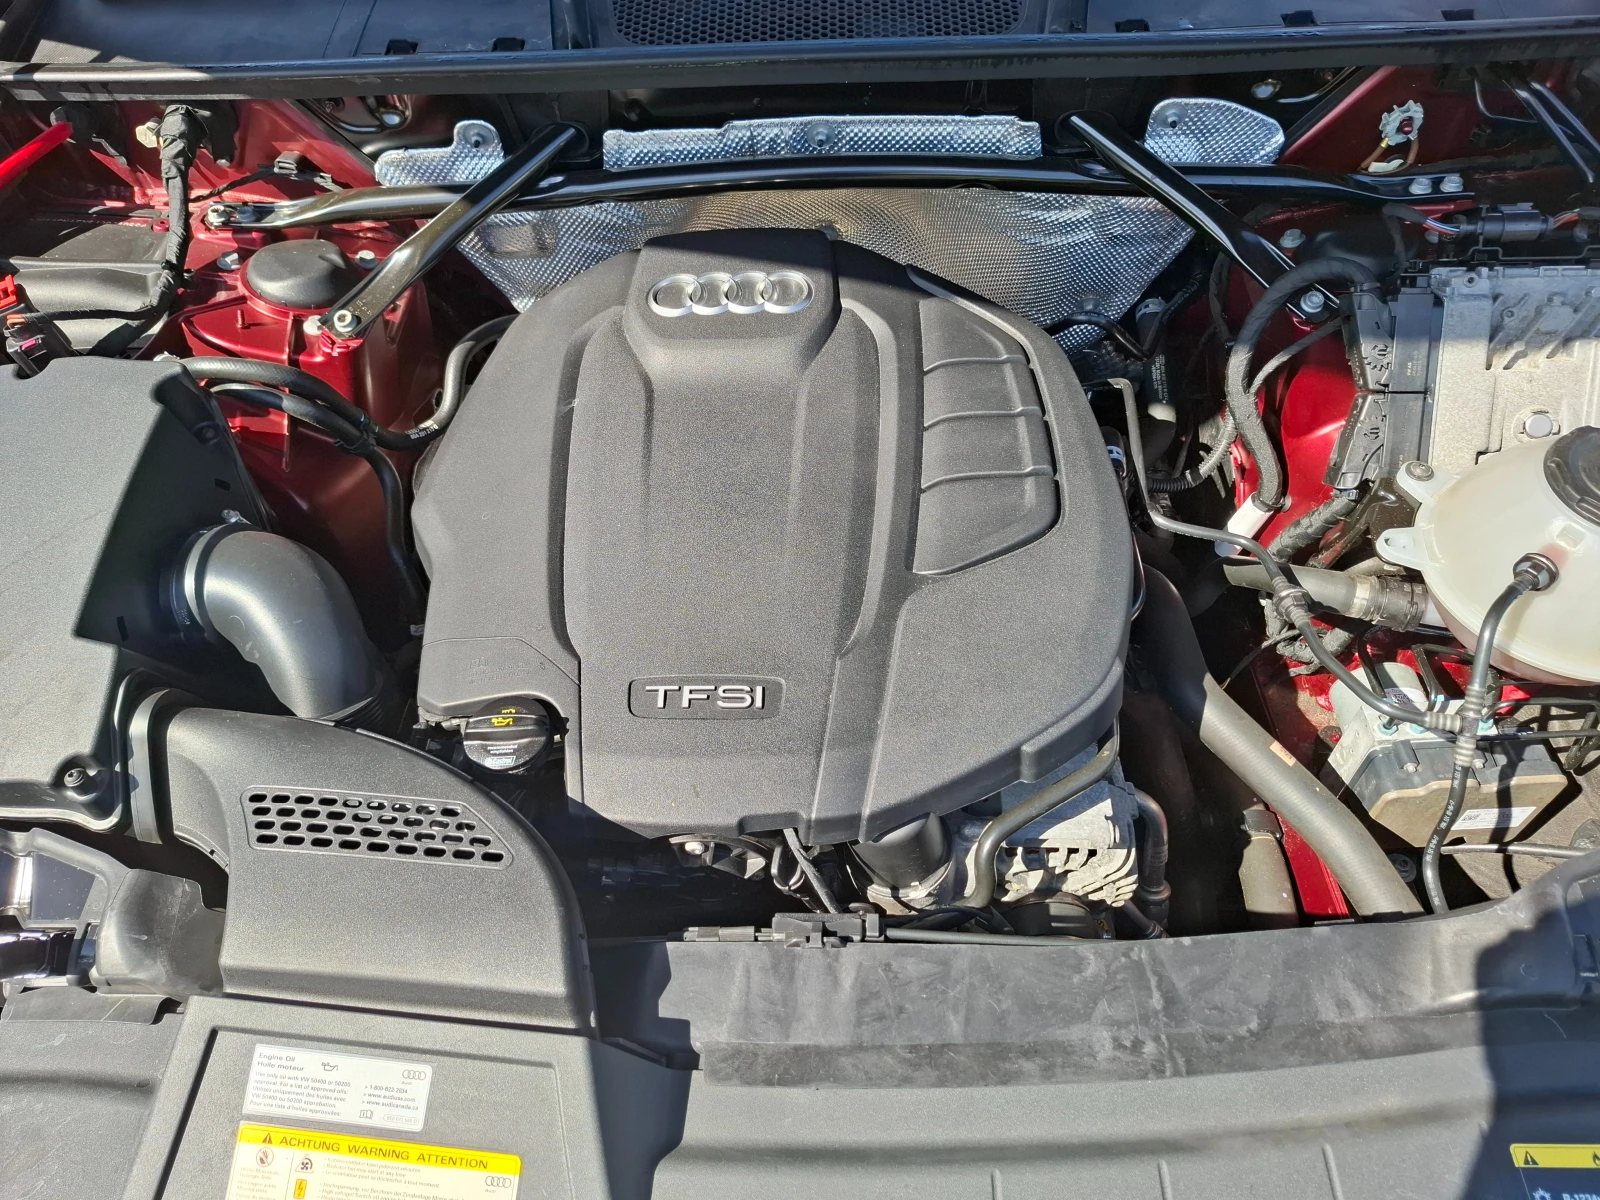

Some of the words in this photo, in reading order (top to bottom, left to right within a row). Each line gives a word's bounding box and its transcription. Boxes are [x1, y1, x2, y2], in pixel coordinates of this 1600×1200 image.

[645, 685, 764, 709] TFSI
[259, 1053, 283, 1061] Engine
[273, 1088, 304, 1097] uniquement
[310, 1085, 336, 1093] approved
[280, 1136, 340, 1152] ACHTUNG
[348, 1144, 410, 1160] WARNING
[416, 1152, 488, 1169] ATTENTION
